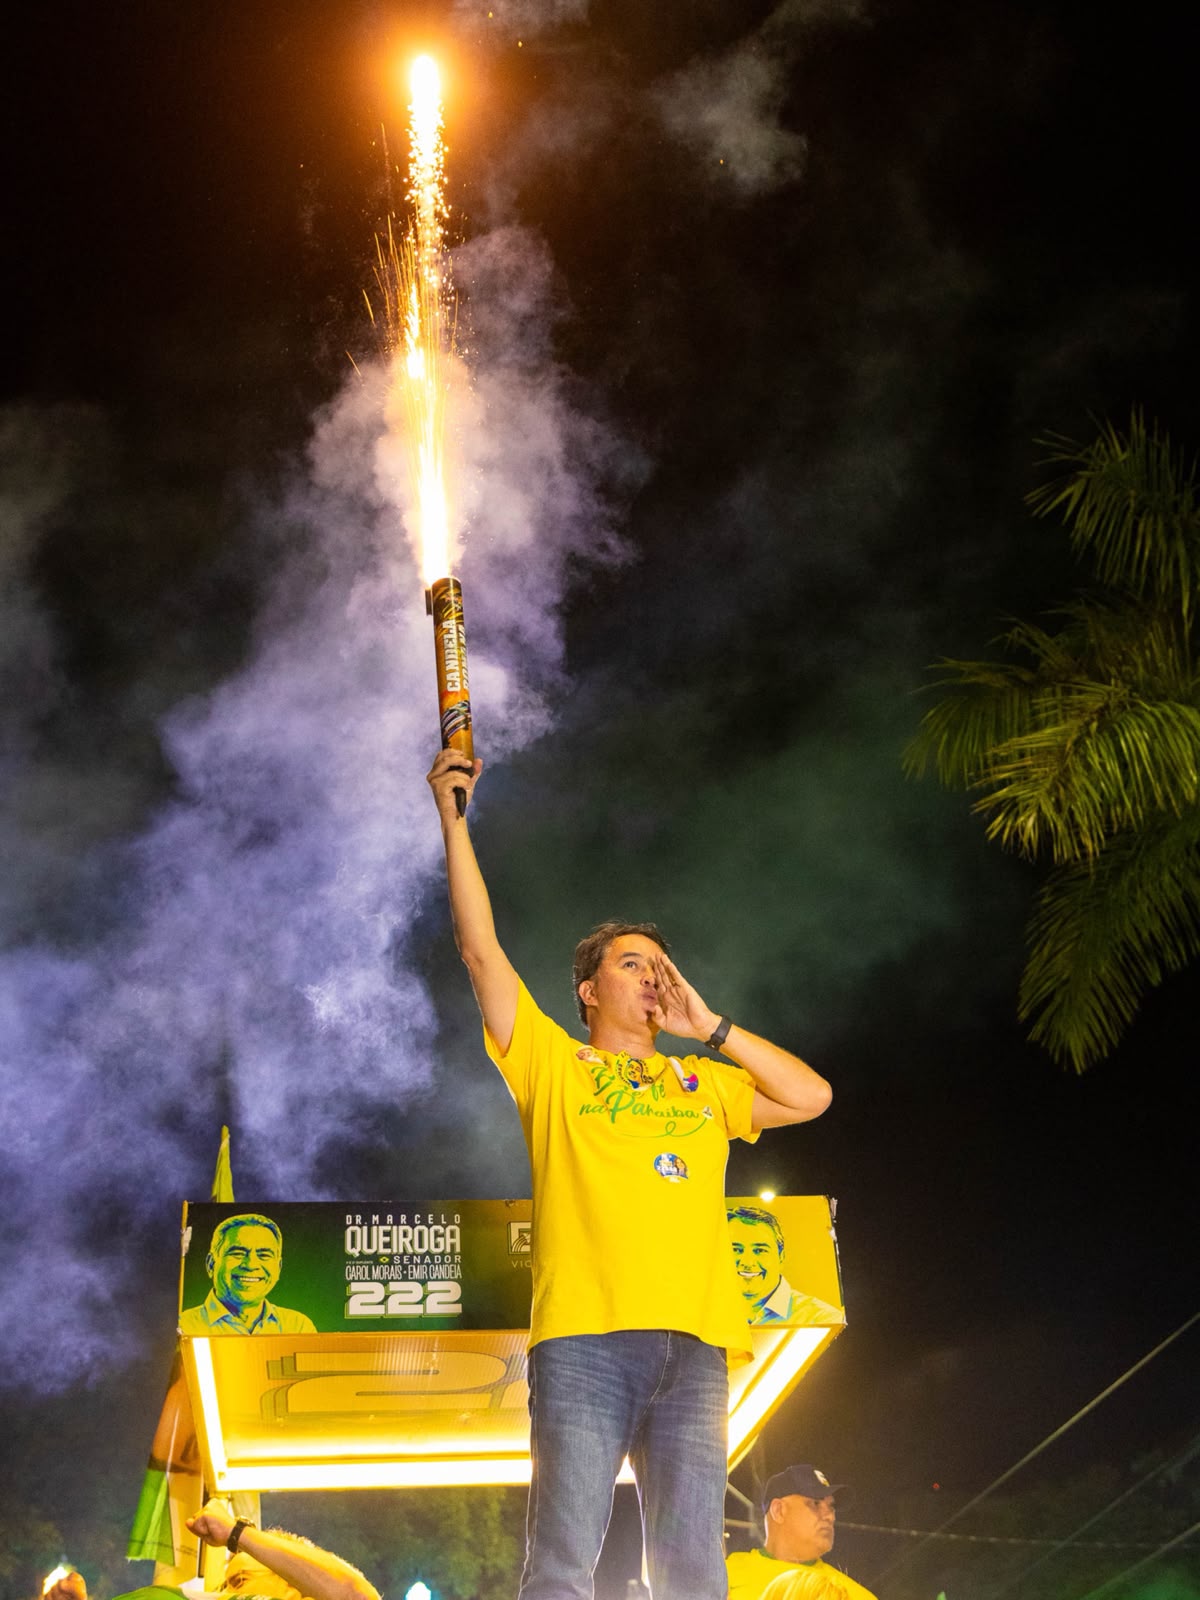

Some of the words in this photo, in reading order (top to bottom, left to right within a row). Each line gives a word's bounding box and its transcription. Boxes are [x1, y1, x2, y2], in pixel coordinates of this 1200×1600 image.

[442, 619, 461, 692] CANDELA
[579, 1103, 604, 1116] na
[372, 1214, 461, 1224] MARCELO
[345, 1225, 461, 1257] QUEIROGA
[393, 1255, 462, 1264] SENADOR
[345, 1265, 371, 1281] CAROL
[372, 1265, 402, 1281] MORAIS
[408, 1264, 428, 1280] EMIR
[429, 1264, 462, 1280] CANDEIA
[345, 1281, 463, 1319] 222
